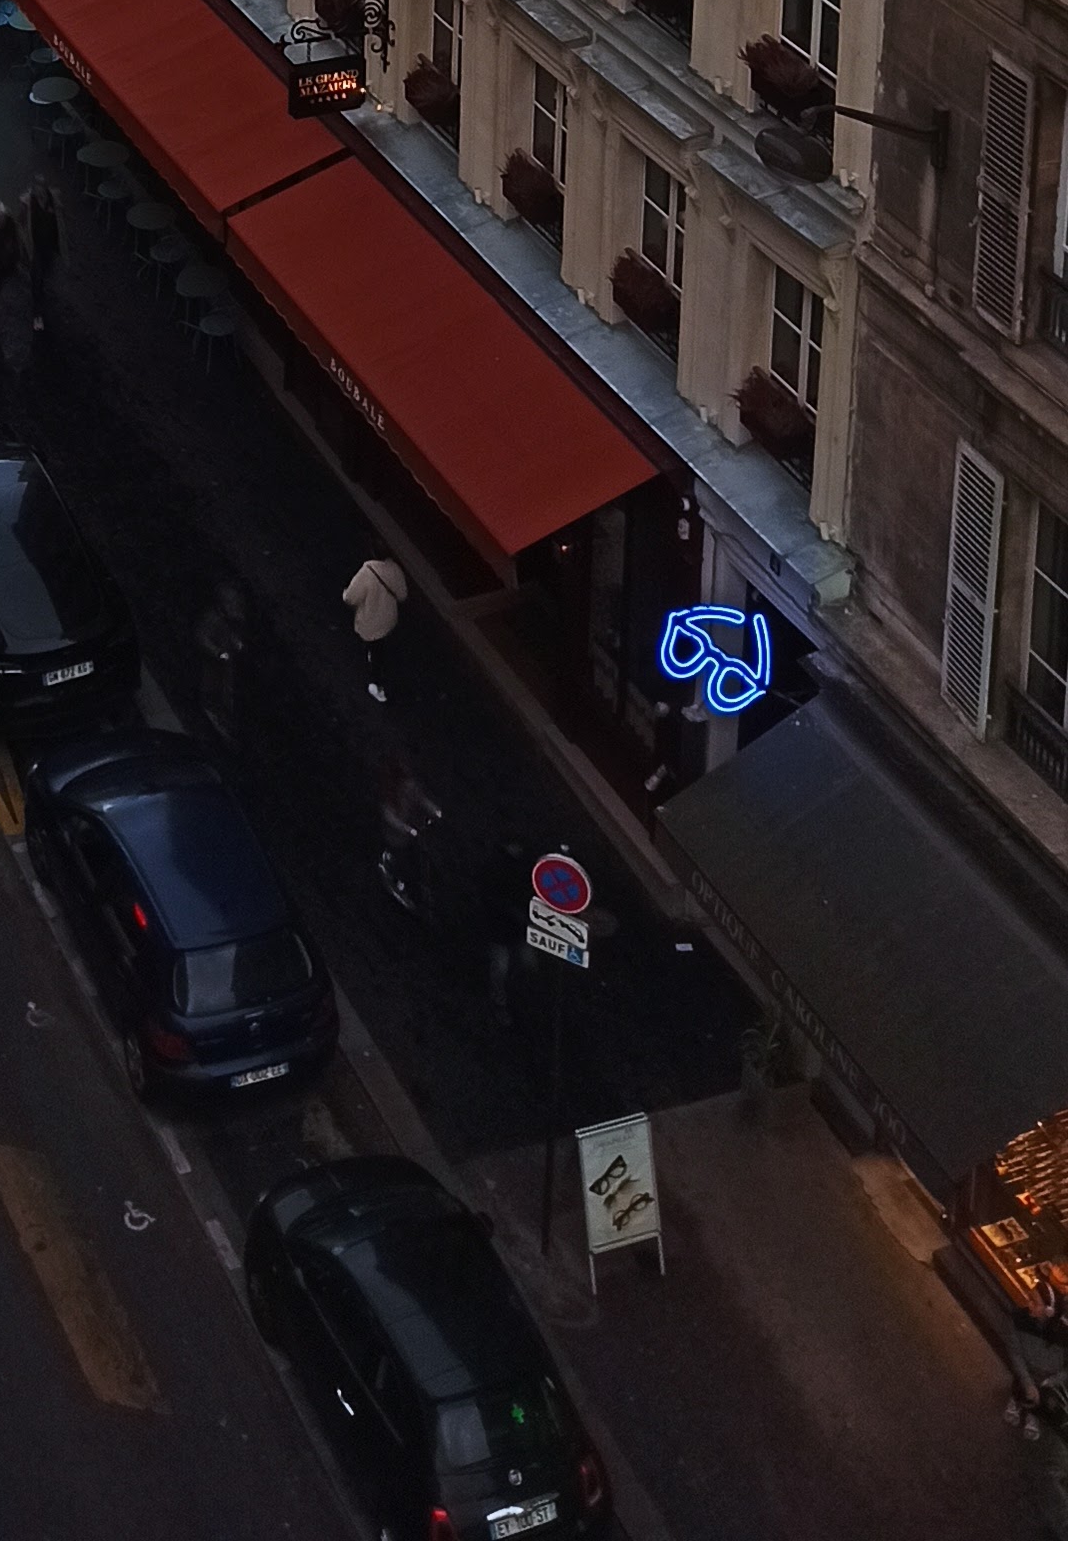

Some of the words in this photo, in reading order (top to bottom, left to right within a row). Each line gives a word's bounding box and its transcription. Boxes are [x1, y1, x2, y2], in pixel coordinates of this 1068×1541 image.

[298, 77, 313, 87] LE
[315, 69, 359, 84] GRAND
[299, 78, 358, 96] MAZARIN
[530, 931, 566, 954] SAUF
